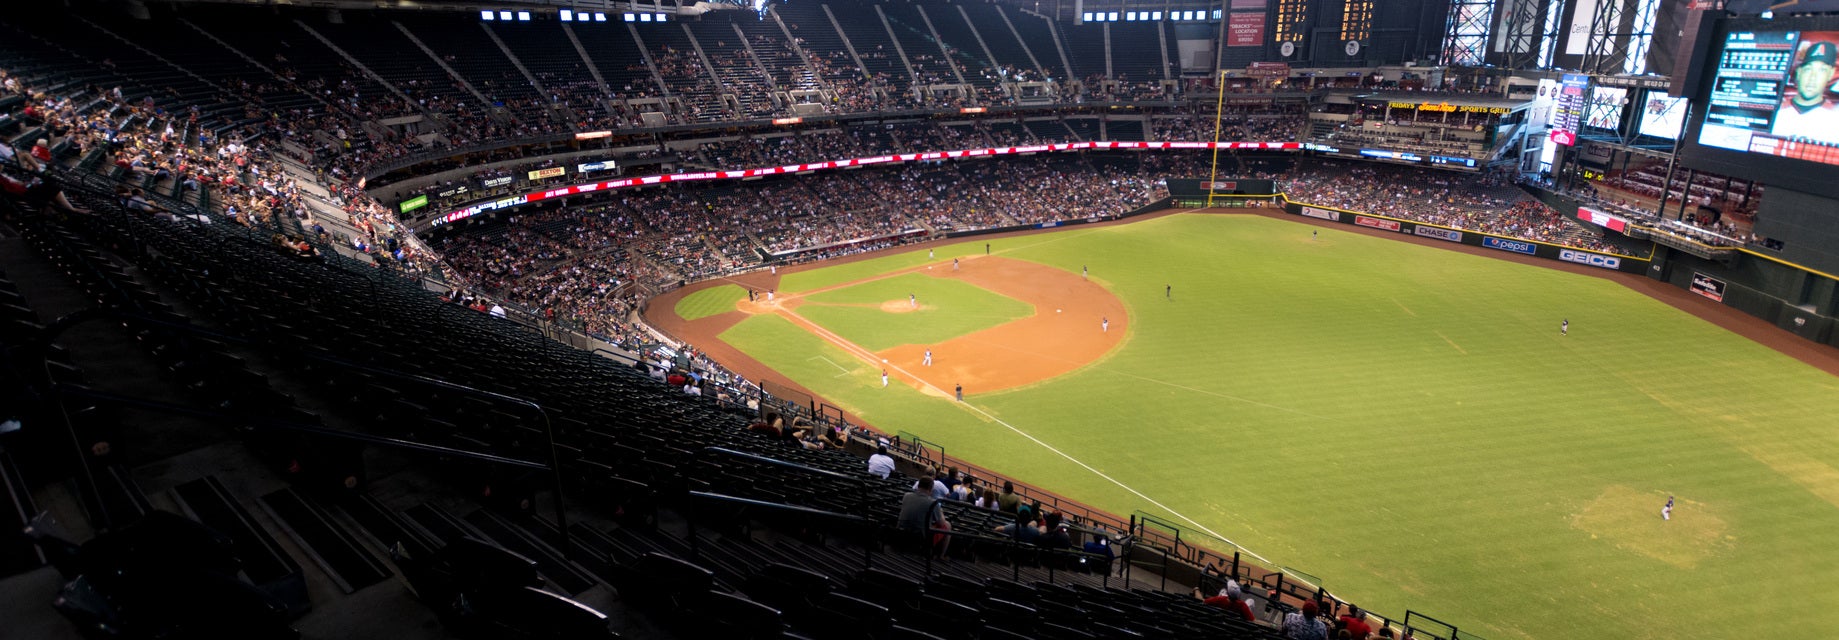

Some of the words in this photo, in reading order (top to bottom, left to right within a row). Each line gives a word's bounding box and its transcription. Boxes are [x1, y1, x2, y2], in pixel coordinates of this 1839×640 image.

[1419, 227, 1448, 238] CHASE
[1500, 241, 1528, 252] pepsi
[1561, 250, 1619, 269] GEICO
